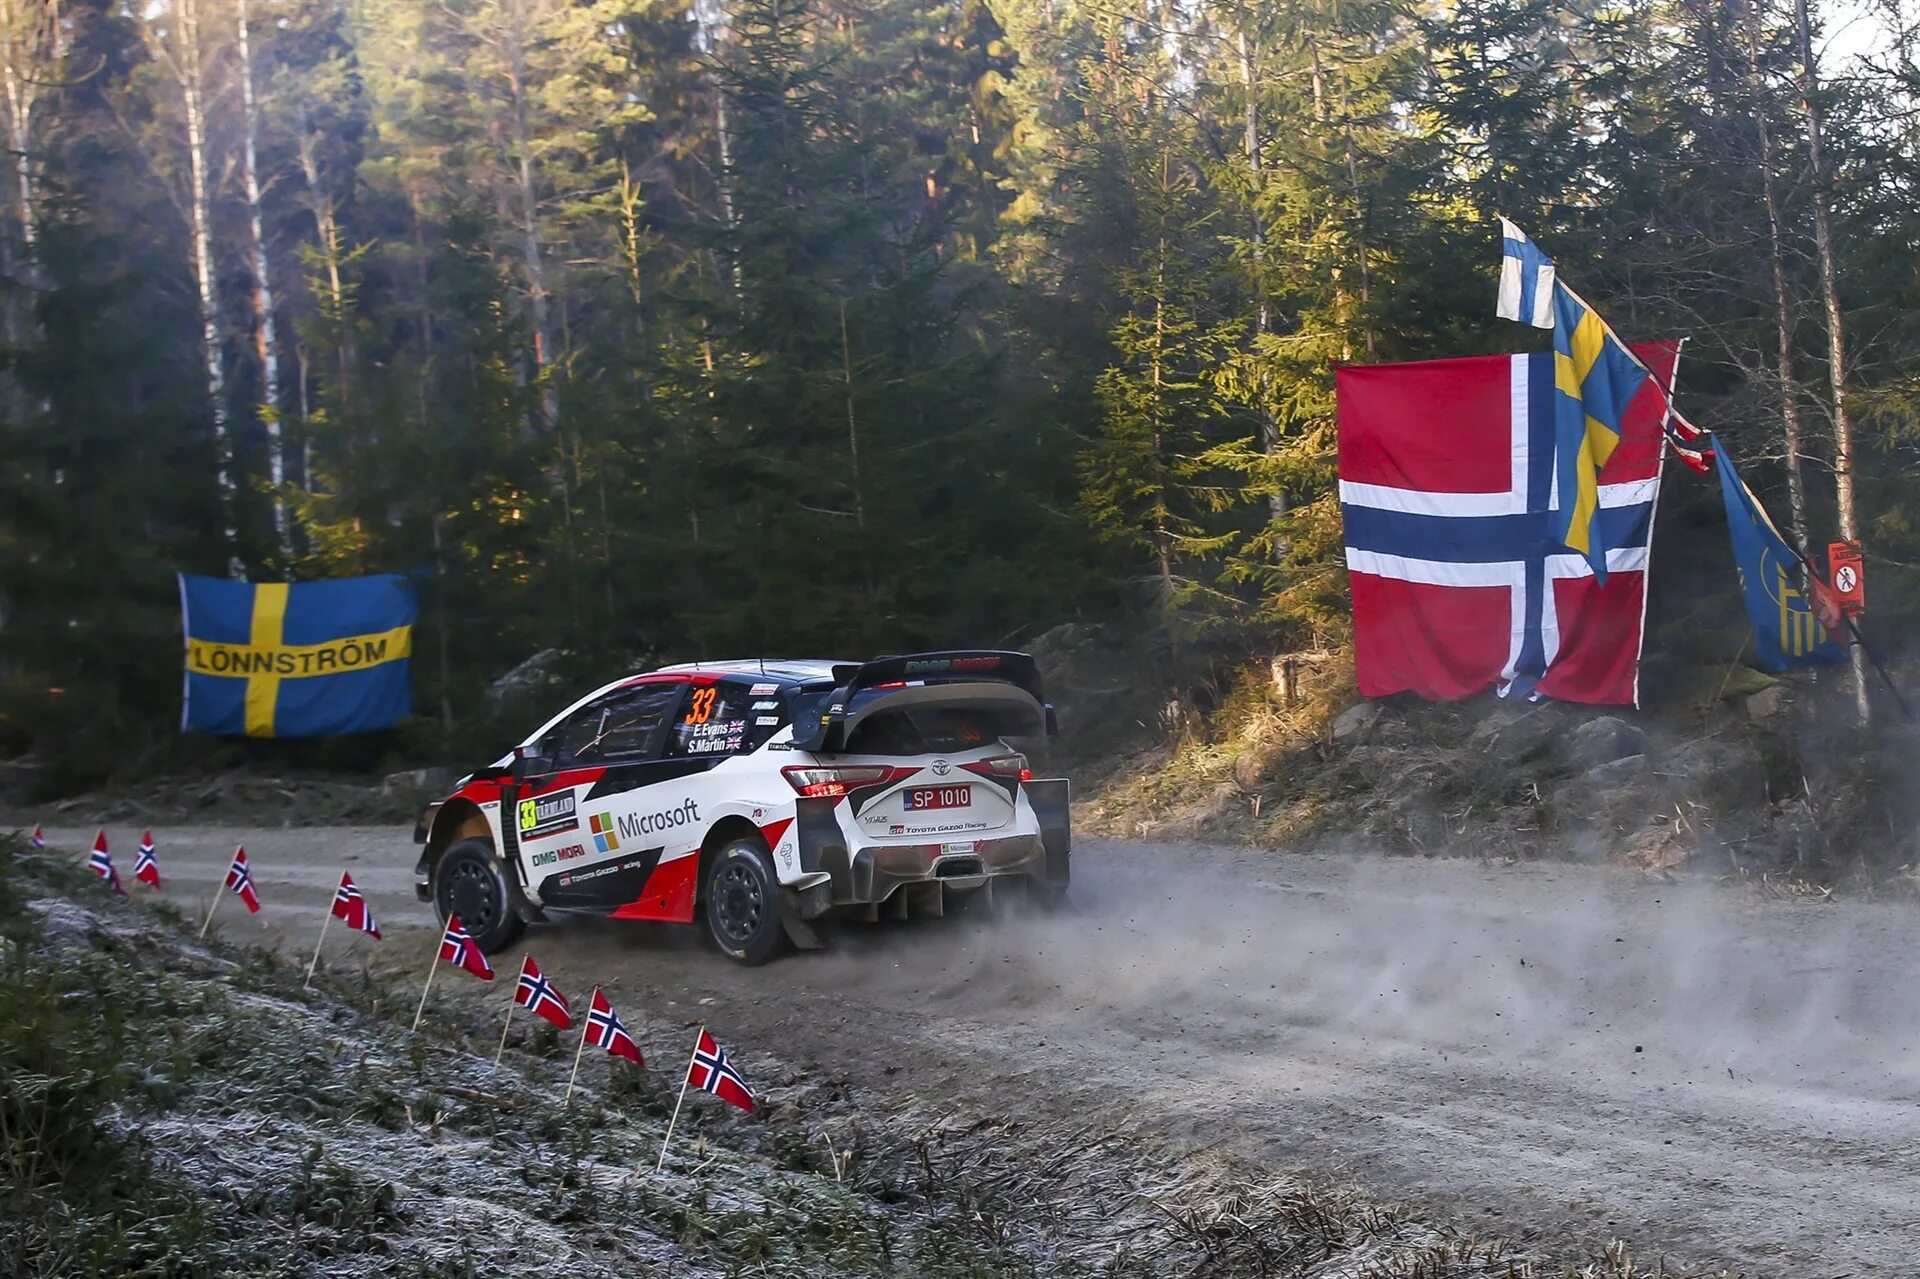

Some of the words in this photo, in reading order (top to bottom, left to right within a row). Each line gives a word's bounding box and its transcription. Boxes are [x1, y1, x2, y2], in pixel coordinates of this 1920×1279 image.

[194, 639, 387, 674] LÖNNSTRÖM
[685, 688, 716, 725] 33
[693, 723, 728, 737] E.Evans
[687, 738, 725, 753] S.Martin
[913, 791, 934, 808] SP
[939, 788, 969, 806] 1010
[521, 800, 536, 830] 33
[618, 797, 701, 840] Microsoft
[938, 824, 963, 832] GAZOO
[532, 850, 557, 867] DMG
[556, 844, 586, 861] MORI
